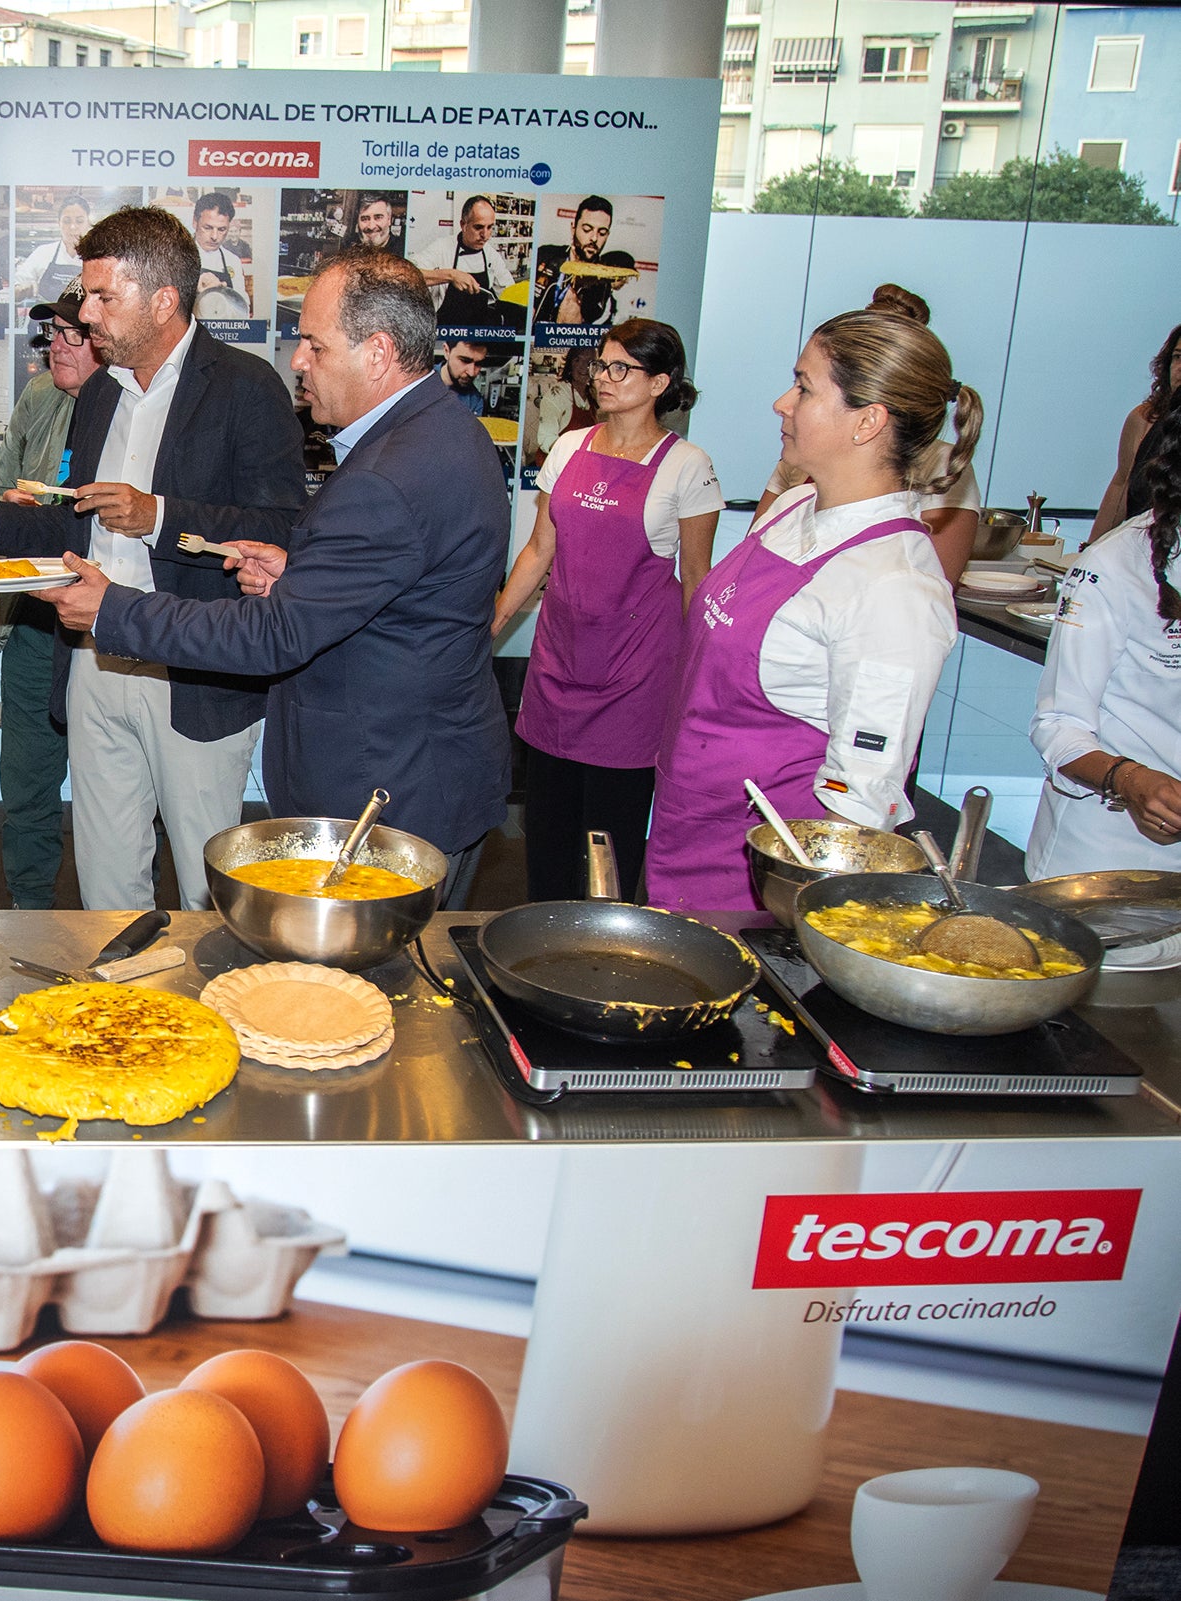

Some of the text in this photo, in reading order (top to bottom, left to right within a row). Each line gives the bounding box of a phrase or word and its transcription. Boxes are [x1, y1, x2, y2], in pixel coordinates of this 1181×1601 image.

[87, 102, 284, 122] INTERNACIONAL
[285, 104, 316, 122] DE
[321, 104, 437, 124] TORTILLA
[442, 107, 473, 125] DE
[478, 107, 589, 128] PATATAS
[594, 110, 658, 130] CON...
[363, 140, 520, 162] Tortilla de patatas
[72, 149, 175, 168] TROFEO
[207, 320, 251, 330] TORTILLERÍA
[545, 326, 555, 334] LA
[557, 327, 587, 336] POSADA
[589, 328, 599, 336] DE
[440, 328, 448, 336] O
[449, 328, 467, 336] POTE
[475, 329, 516, 338] BETANZOS
[549, 338, 577, 346] GUMIEL
[579, 338, 592, 346] DEL
[573, 490, 619, 506] LA TEULADA
[581, 500, 605, 512] ELCHE
[803, 1294, 1057, 1324] Disfruta cocinando
